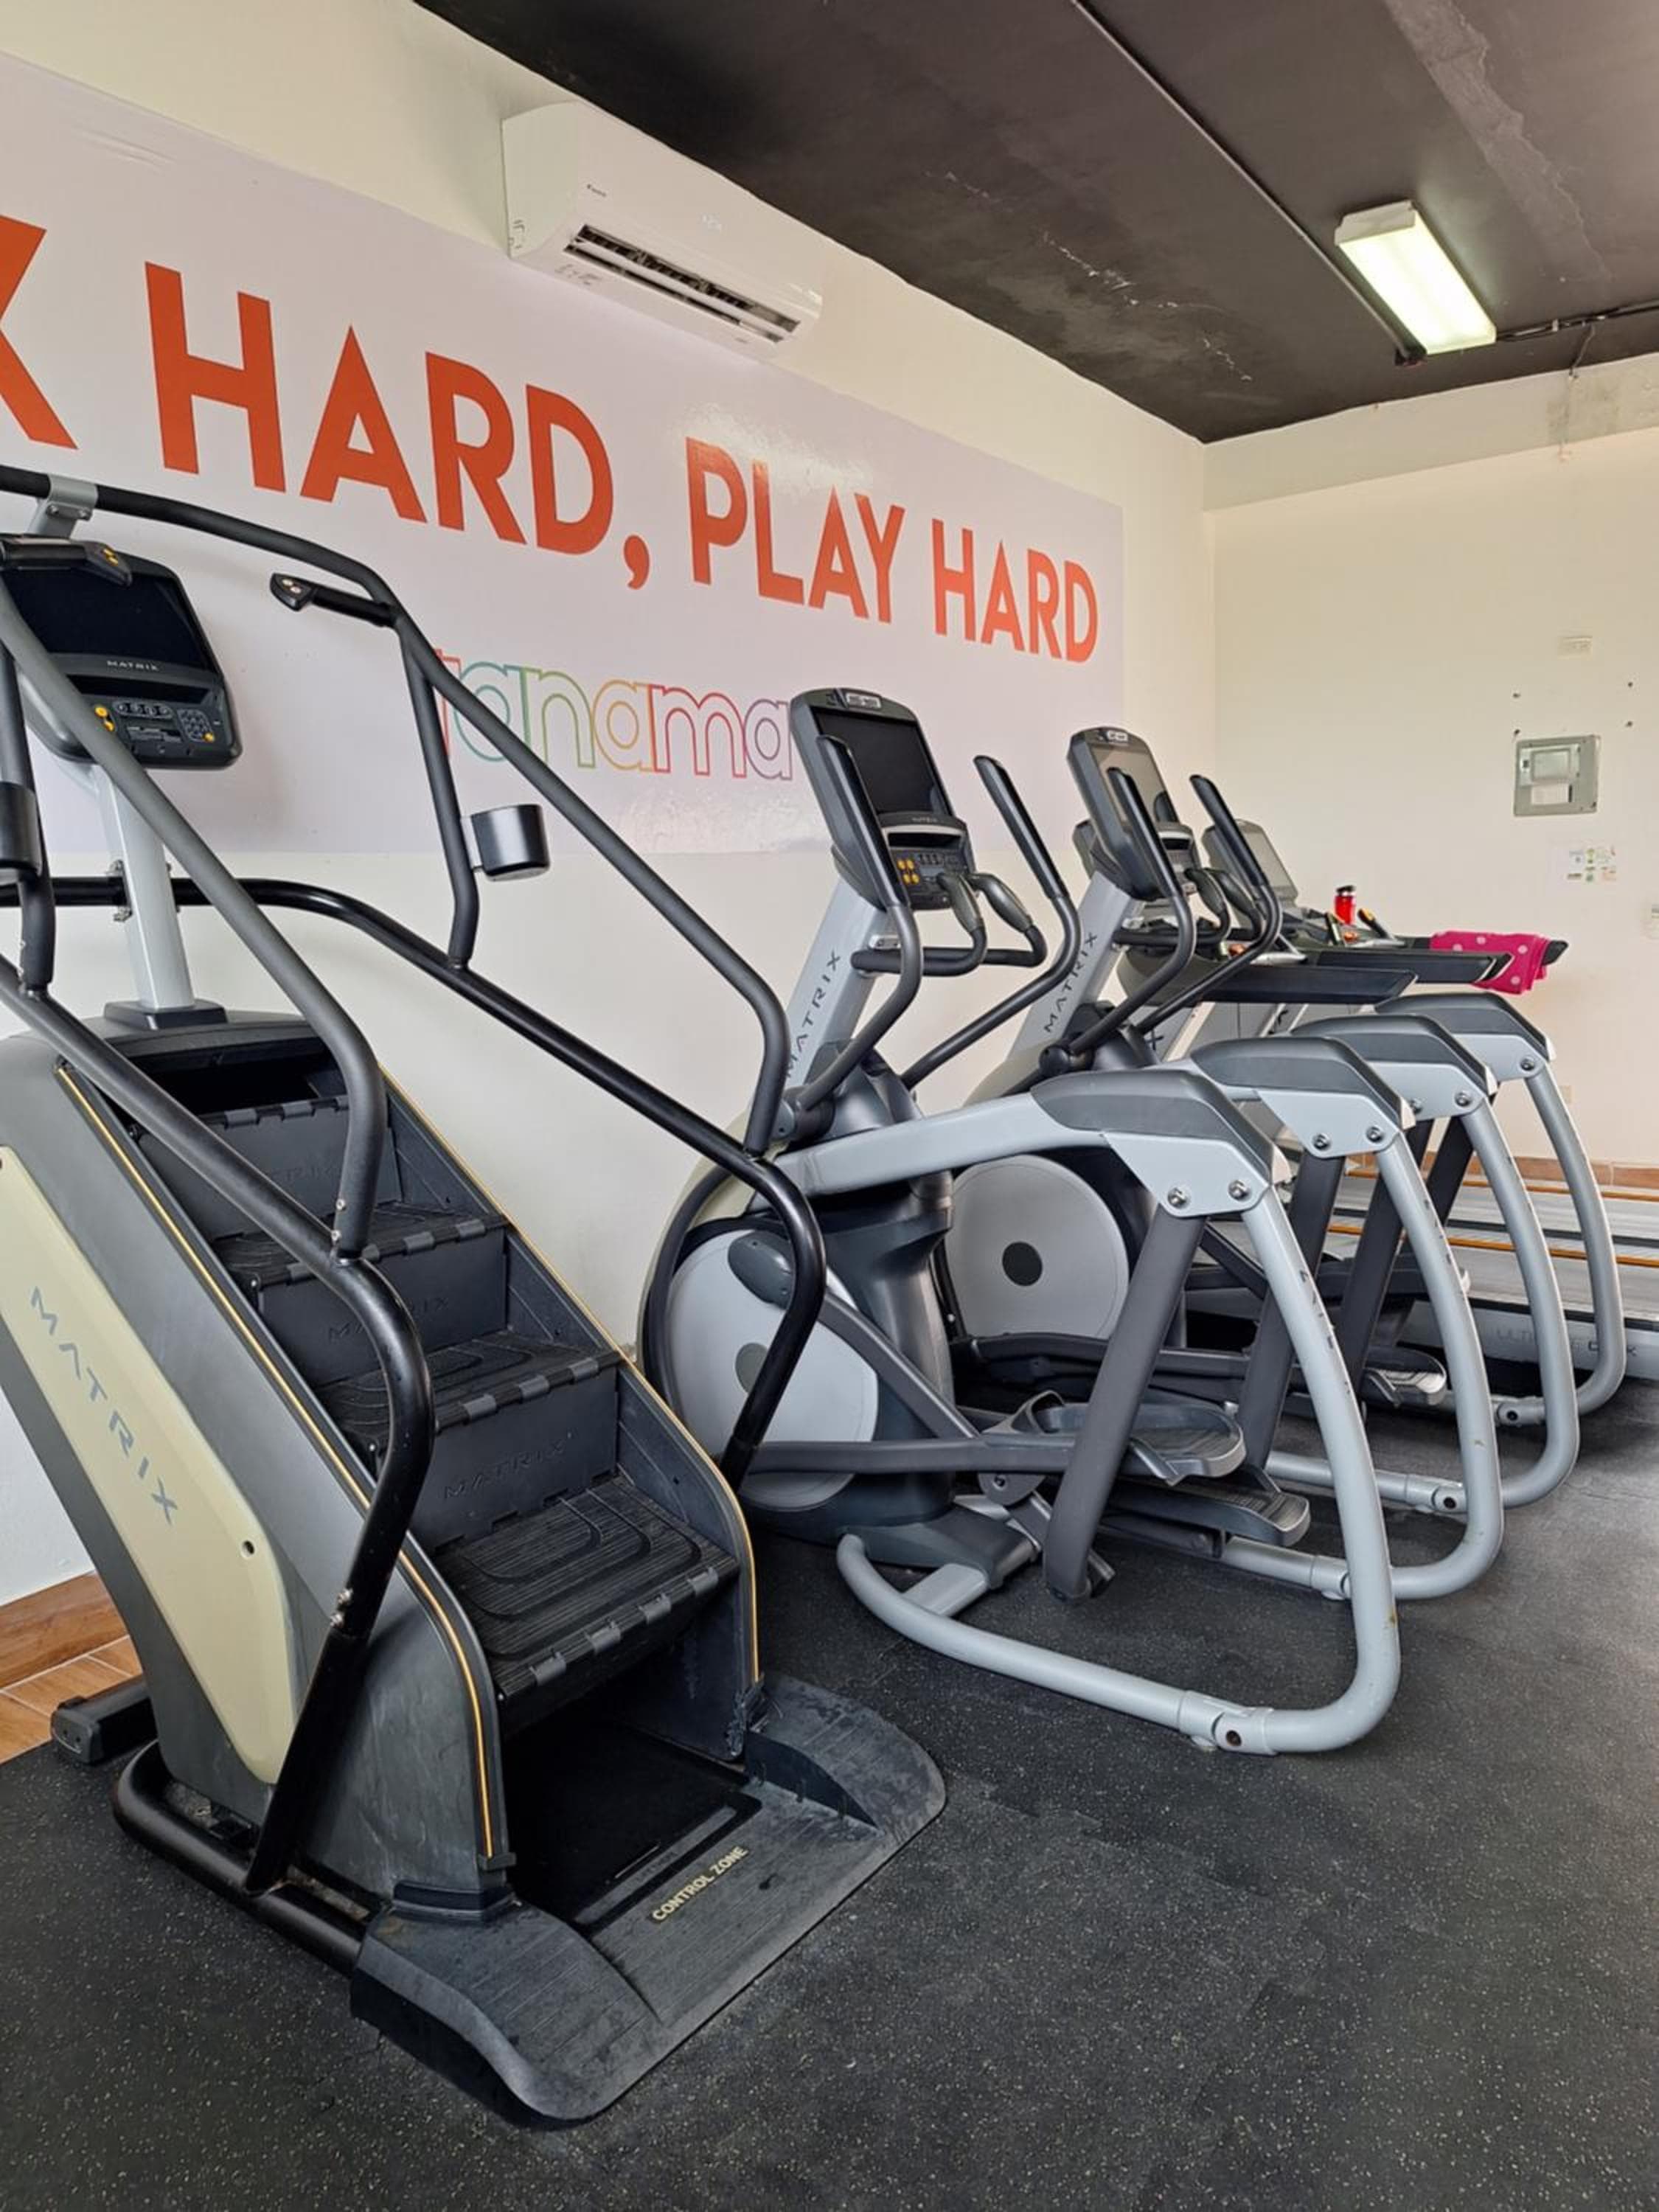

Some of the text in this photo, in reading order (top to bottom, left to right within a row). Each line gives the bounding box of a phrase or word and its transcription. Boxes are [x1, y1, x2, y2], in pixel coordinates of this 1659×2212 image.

[145, 260, 650, 590] HARD,
[685, 435, 906, 625] PLAY
[931, 518, 1099, 664] HARD
[106, 660, 158, 670] MATRIX
[1045, 931, 1099, 1034] MATRIX
[29, 1285, 179, 1527] MATRIX
[652, 1874, 715, 1921] CONTROL
[709, 1846, 749, 1875] ZONE
